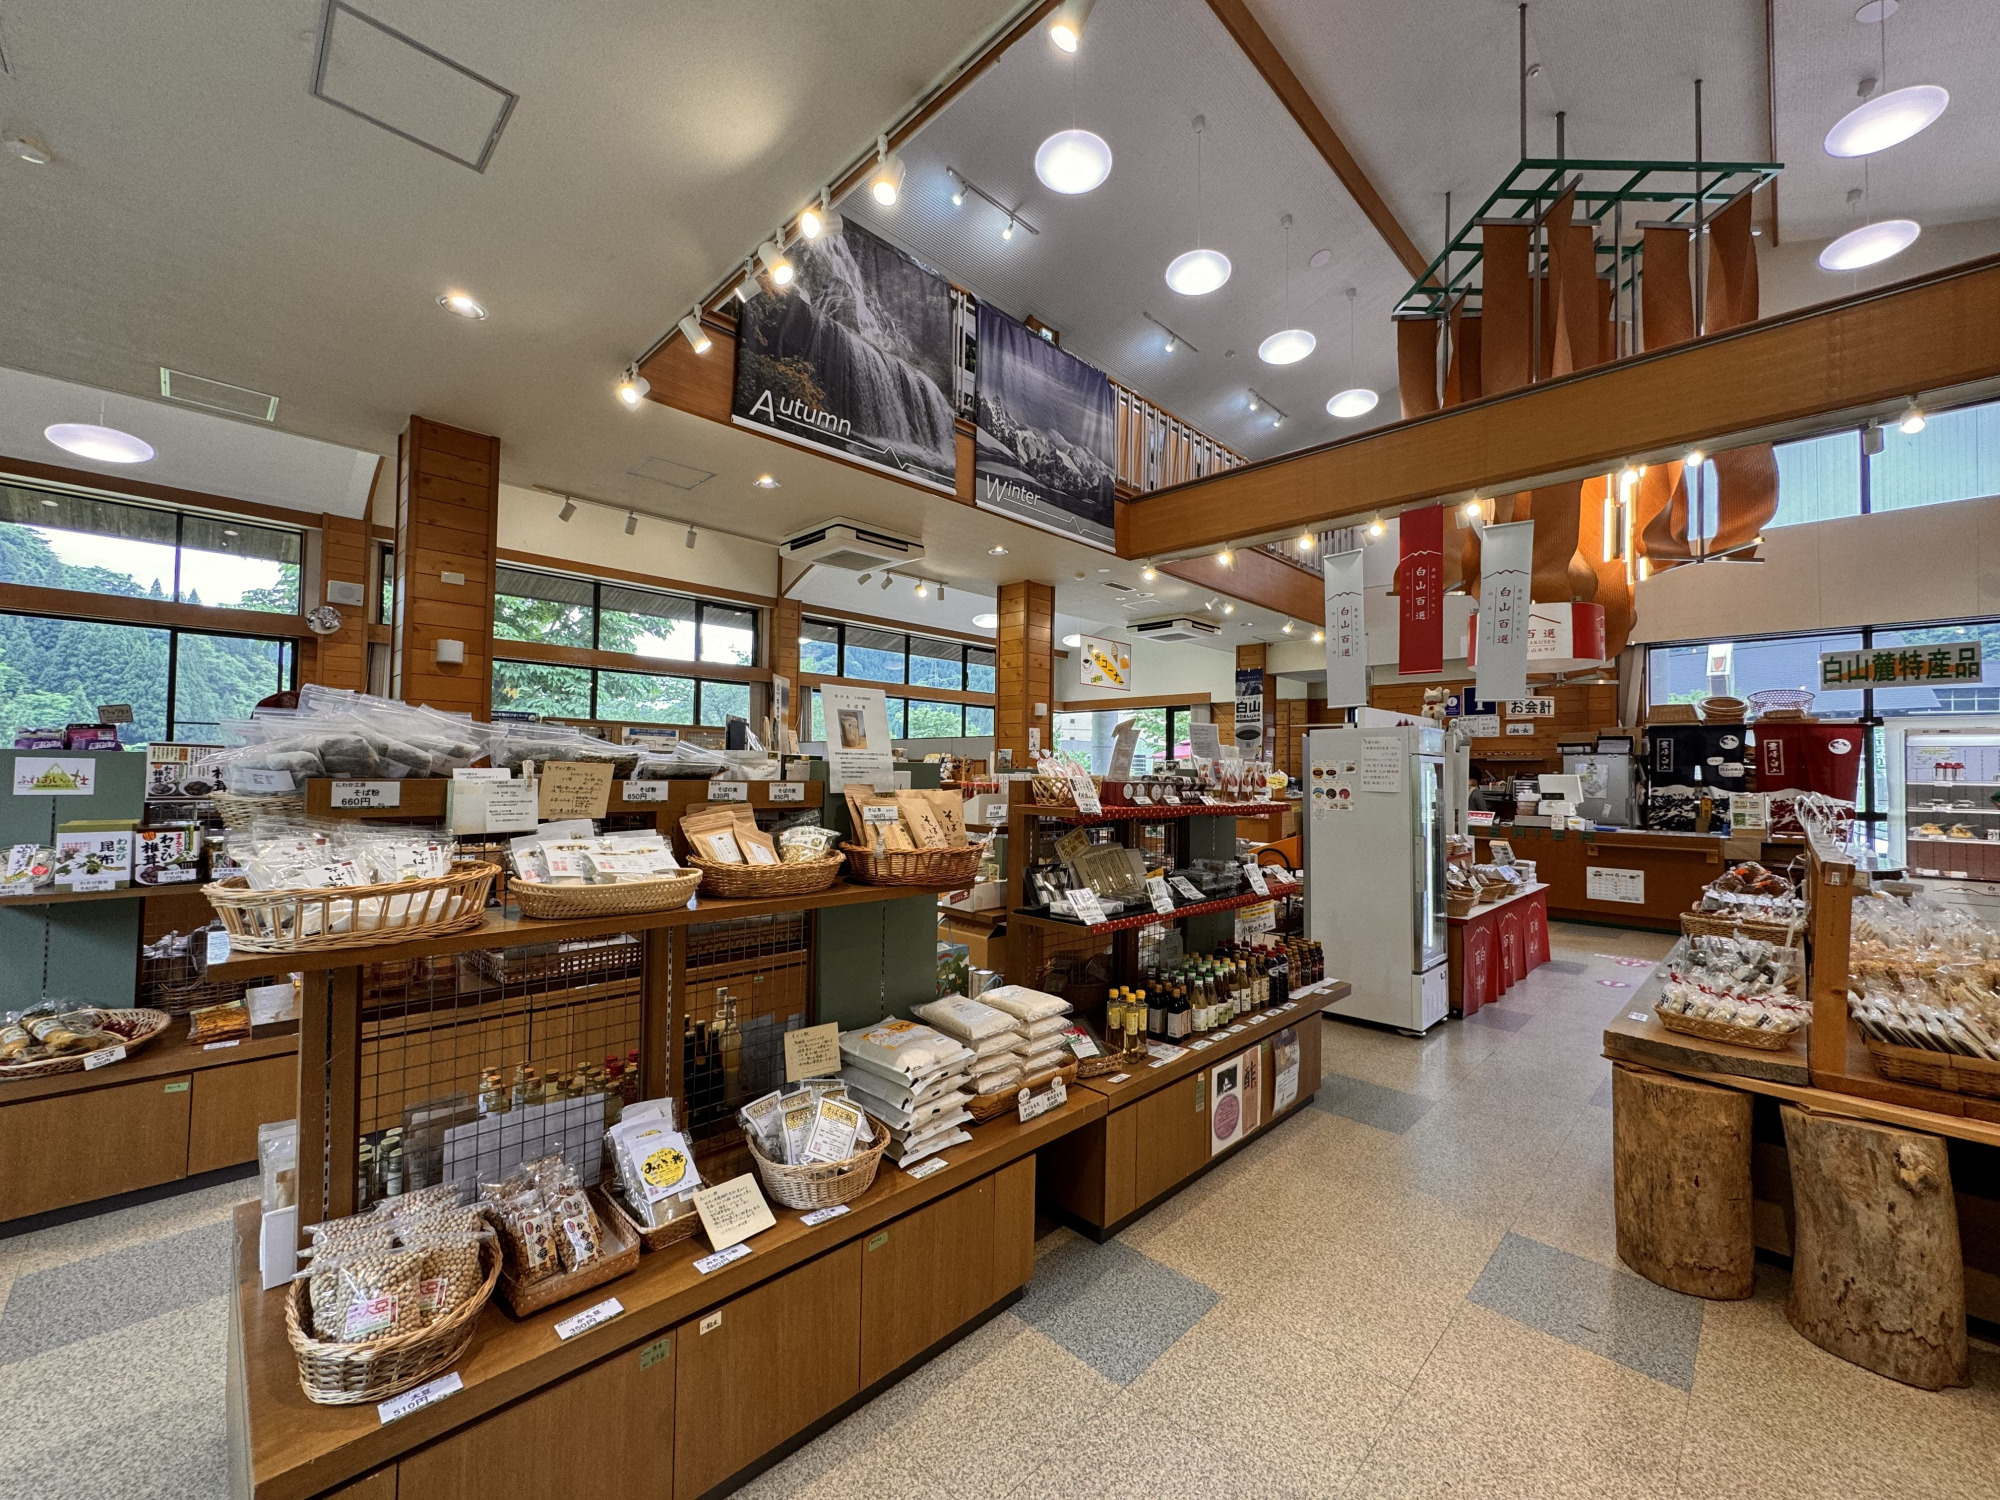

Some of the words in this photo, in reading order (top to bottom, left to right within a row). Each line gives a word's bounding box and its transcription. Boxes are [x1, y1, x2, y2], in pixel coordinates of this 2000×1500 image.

[750, 389, 851, 436] Autumn
[986, 475, 1041, 506] Winter
[1415, 566, 1427, 620] 白山百選
[1497, 586, 1512, 644] 白山百選
[1340, 606, 1351, 657] 白山百選
[1823, 648, 1980, 684] 白山麓特産品
[1236, 701, 1261, 713] 白山
[1511, 700, 1552, 714] お会計
[341, 797, 371, 806] 660円
[353, 789, 380, 797] そば粉
[99, 840, 115, 866] 昆布
[159, 833, 175, 861] わさび
[361, 1299, 390, 1318] 大豆
[393, 1395, 430, 1417] 510円
[411, 1387, 431, 1402] 大豆
